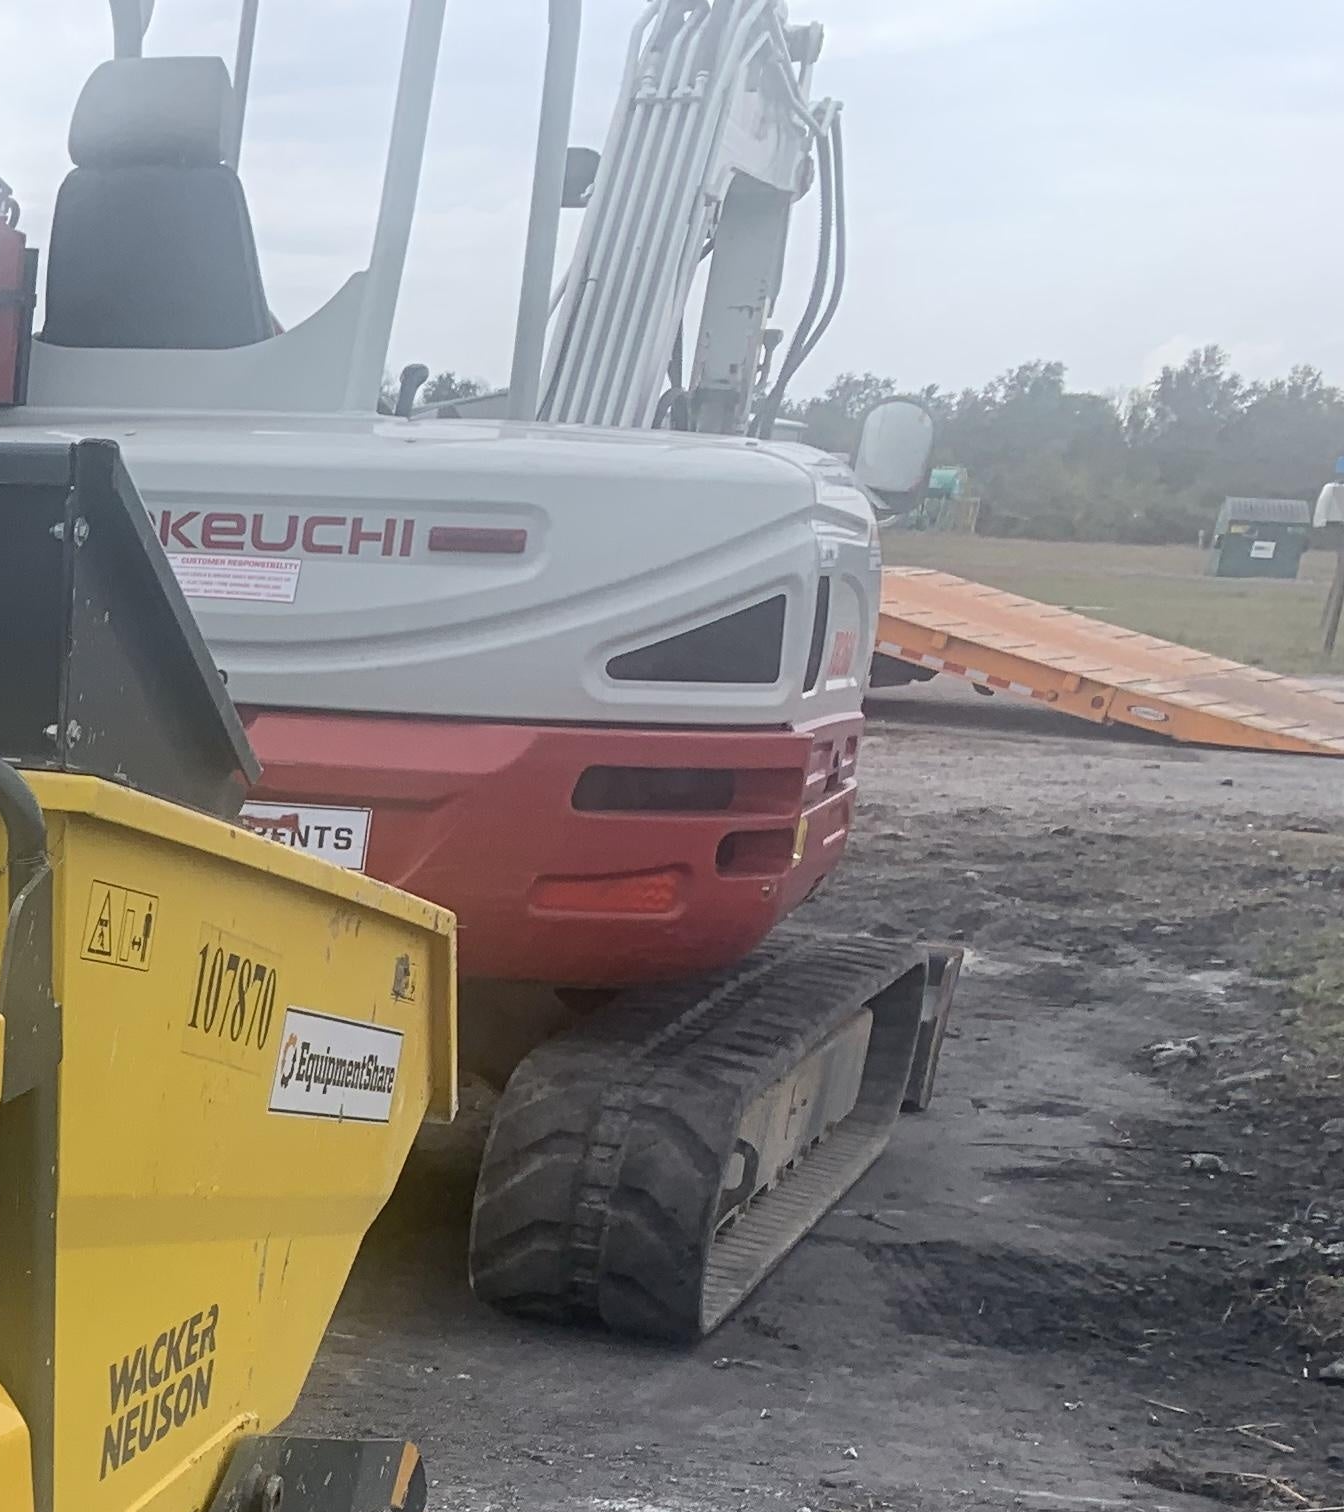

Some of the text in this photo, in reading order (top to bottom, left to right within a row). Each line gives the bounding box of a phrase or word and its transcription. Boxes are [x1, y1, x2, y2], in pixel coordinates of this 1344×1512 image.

[148, 510, 415, 557] KEUCHI
[180, 556, 299, 571] CUSTOMER RESPONSIBILITY
[187, 942, 277, 1050] 107870
[295, 1041, 395, 1095] EquipmentShare
[109, 1303, 219, 1416] WACKER
[99, 1358, 214, 1482] NEUSON
